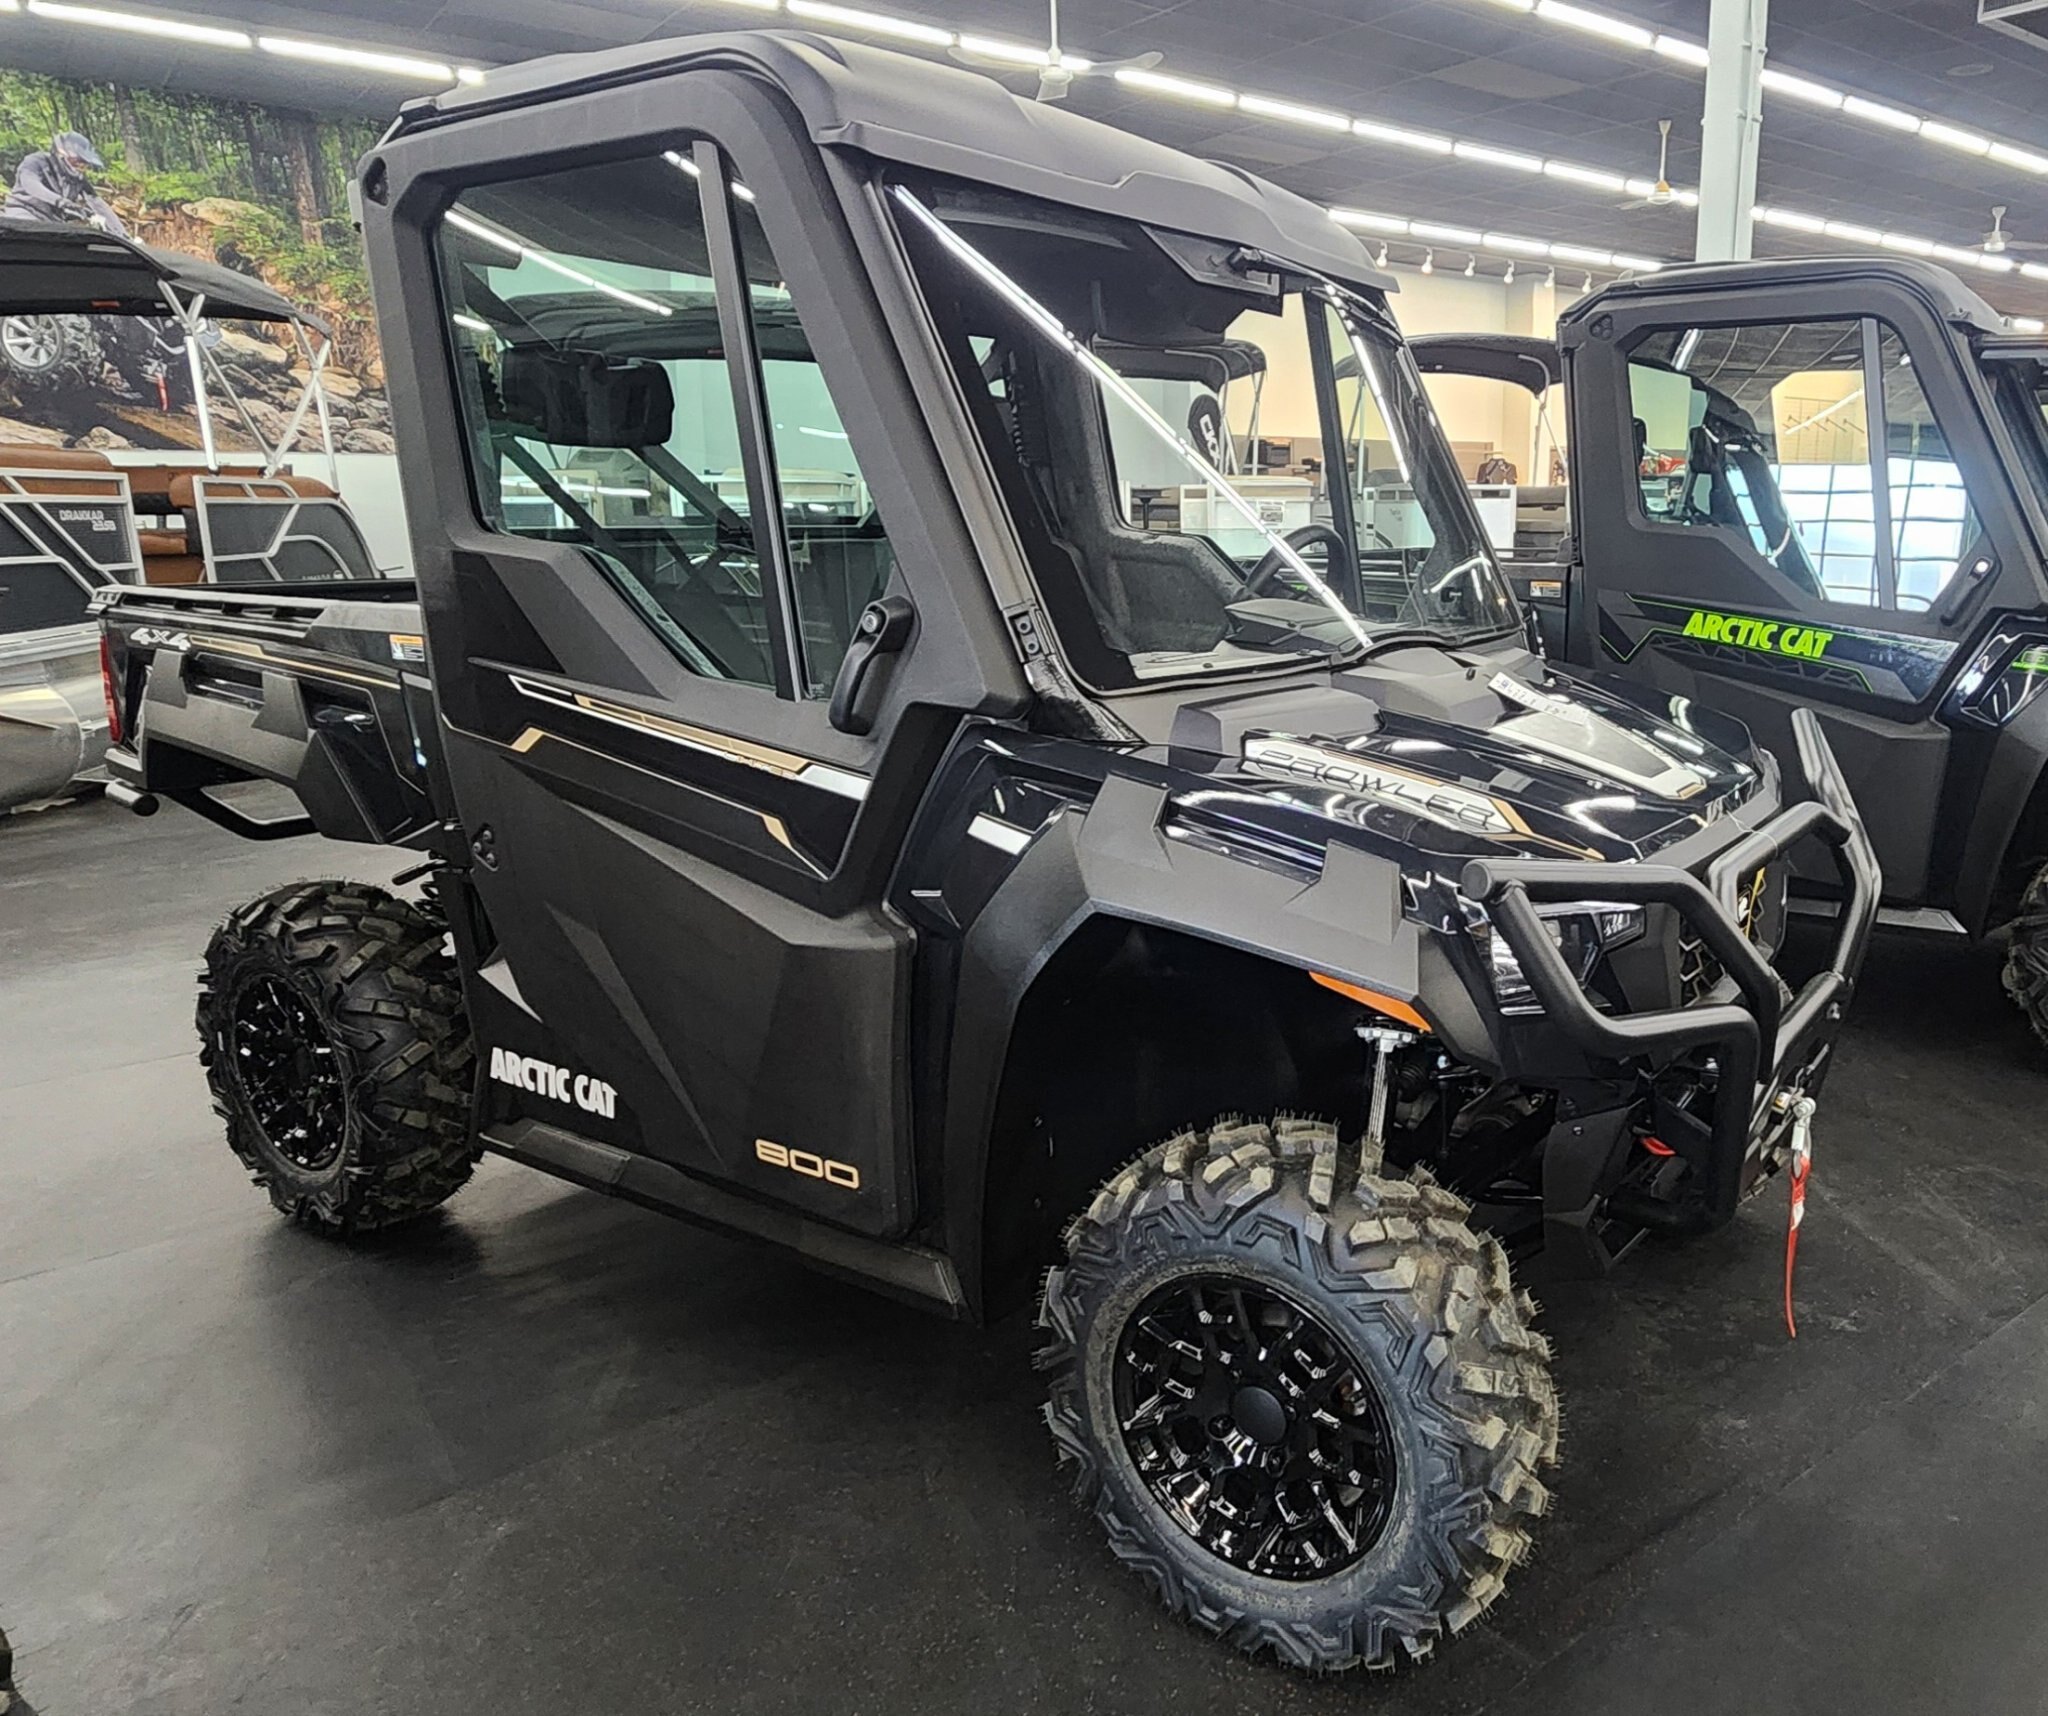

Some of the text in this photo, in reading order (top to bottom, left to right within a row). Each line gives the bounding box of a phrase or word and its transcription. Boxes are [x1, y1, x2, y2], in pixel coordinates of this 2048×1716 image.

[59, 509, 104, 521] DRAKKAR
[1682, 611, 1834, 659] ARCTIC CAT
[1258, 749, 1496, 831] PROWLER
[490, 1046, 618, 1119] ARCTIC CAT
[755, 1138, 860, 1189] 800
